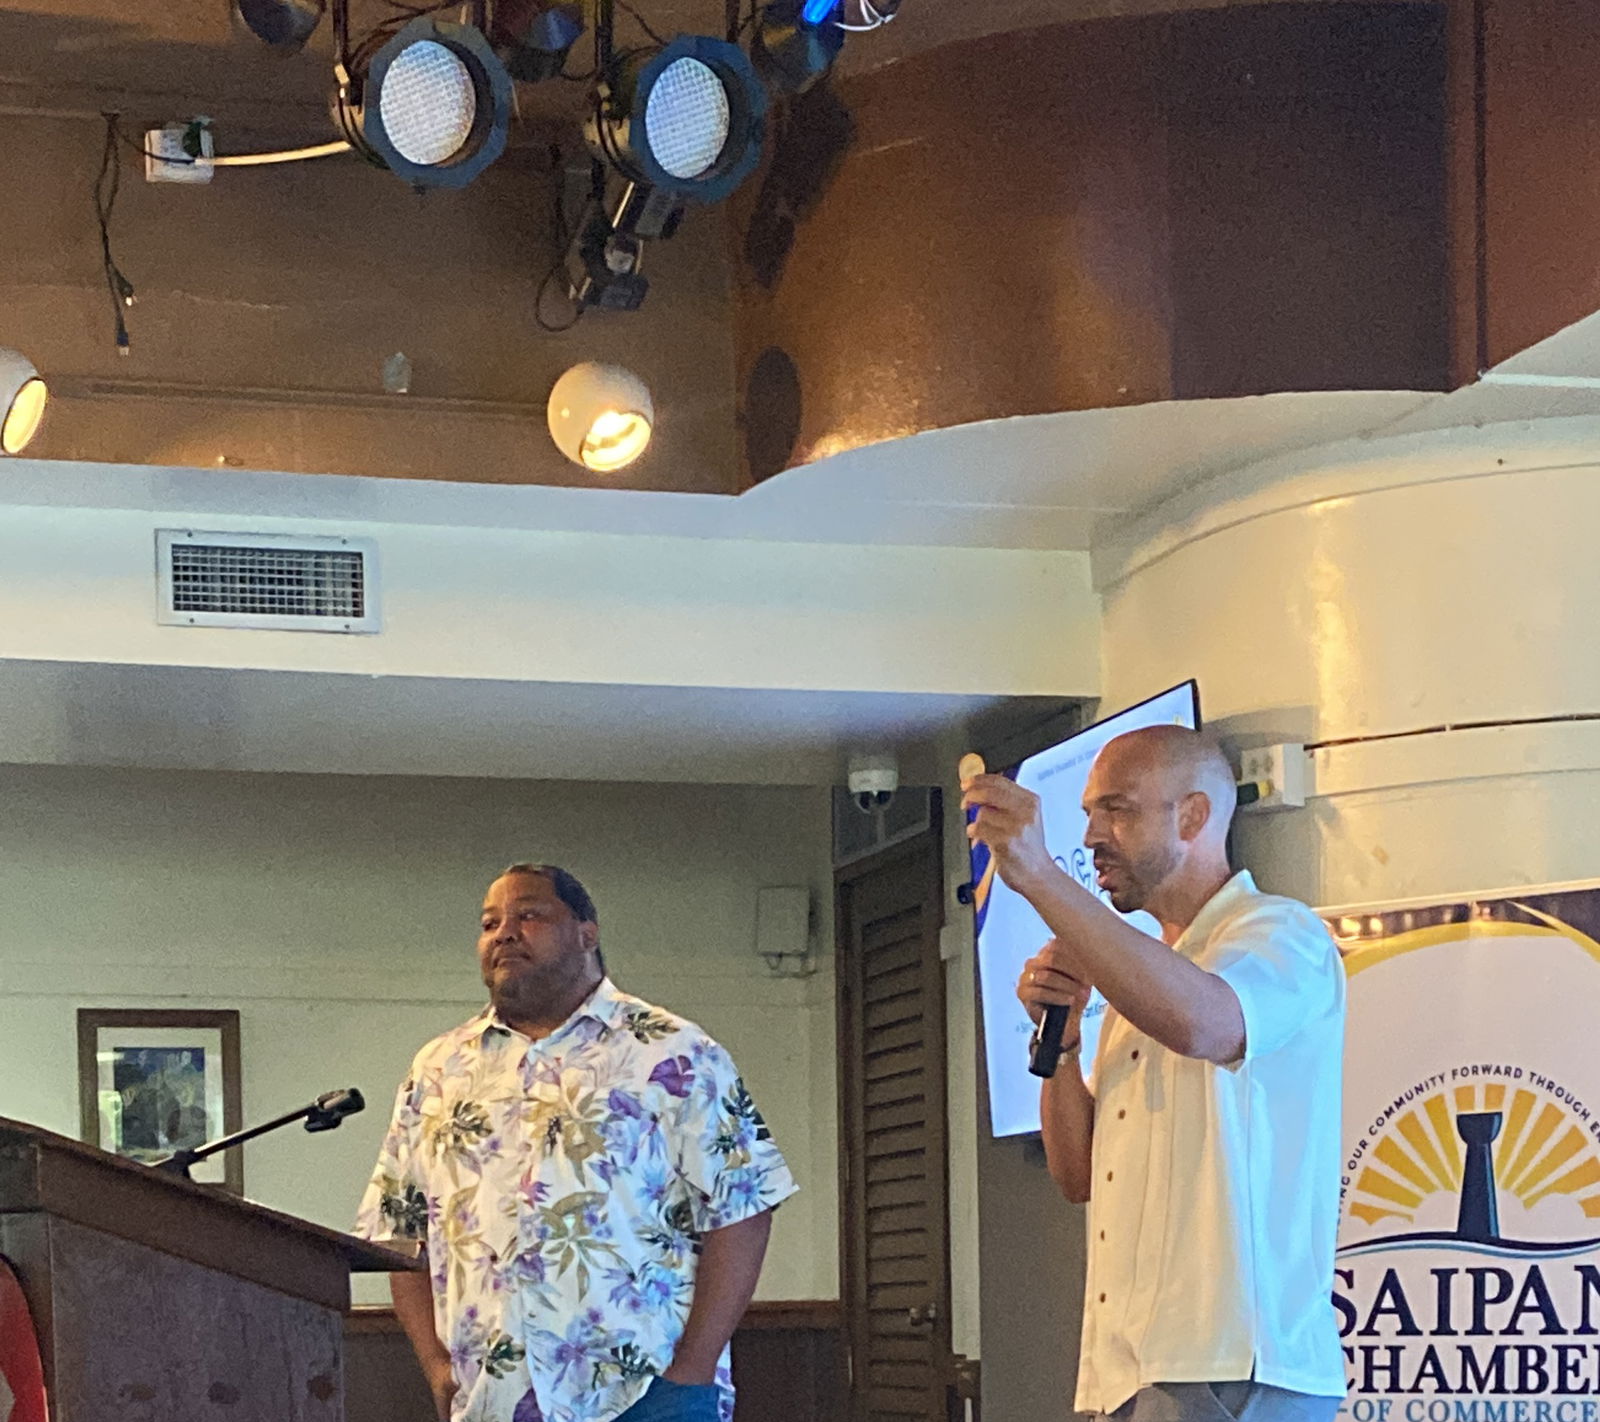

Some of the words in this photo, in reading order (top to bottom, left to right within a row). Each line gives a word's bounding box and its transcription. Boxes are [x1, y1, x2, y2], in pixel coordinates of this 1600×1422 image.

[1348, 1139, 1369, 1170] OUR
[1368, 1073, 1446, 1136] COMMUNITY
[1452, 1064, 1523, 1080] FORWARD
[1529, 1072, 1591, 1121] THROUGH
[1341, 1344, 1600, 1395] HAMBE
